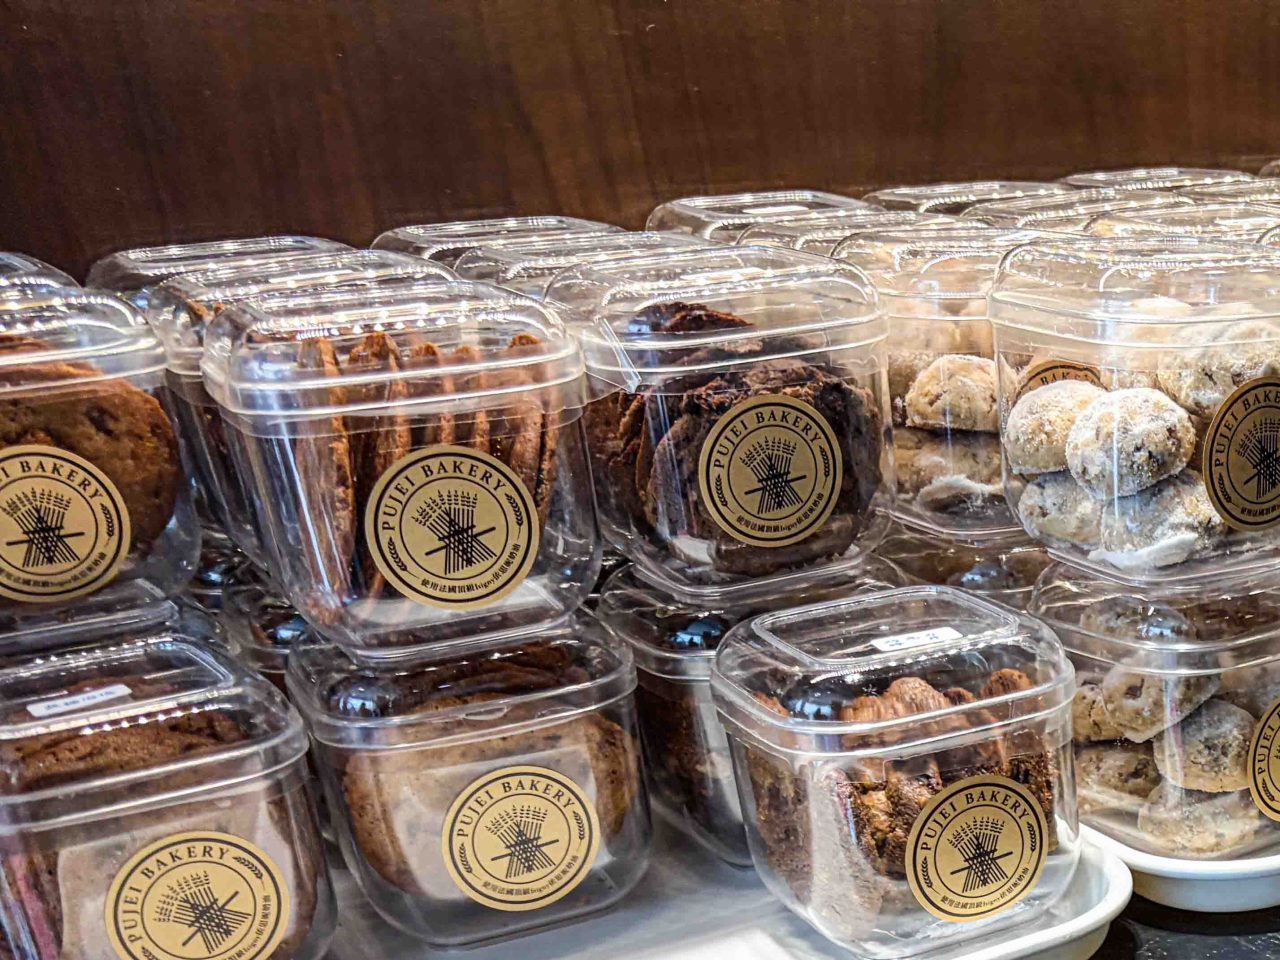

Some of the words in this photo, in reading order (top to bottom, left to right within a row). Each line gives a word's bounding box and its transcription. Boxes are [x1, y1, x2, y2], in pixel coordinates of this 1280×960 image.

[714, 420, 748, 469] PUJEI
[755, 409, 822, 445] BAKERY
[1214, 411, 1238, 468] PUJEI
[20, 460, 103, 499] BAKERY
[382, 475, 415, 531] PUJEI
[421, 460, 506, 492] BAKERY
[1257, 725, 1275, 775] PUJEI
[457, 790, 494, 837] PUJEI
[501, 779, 575, 809] BAKERY
[920, 802, 957, 850] PUJEI
[965, 790, 1030, 819] BAKERY
[122, 885, 142, 944] PUJEI
[140, 845, 229, 879] BAKERY
